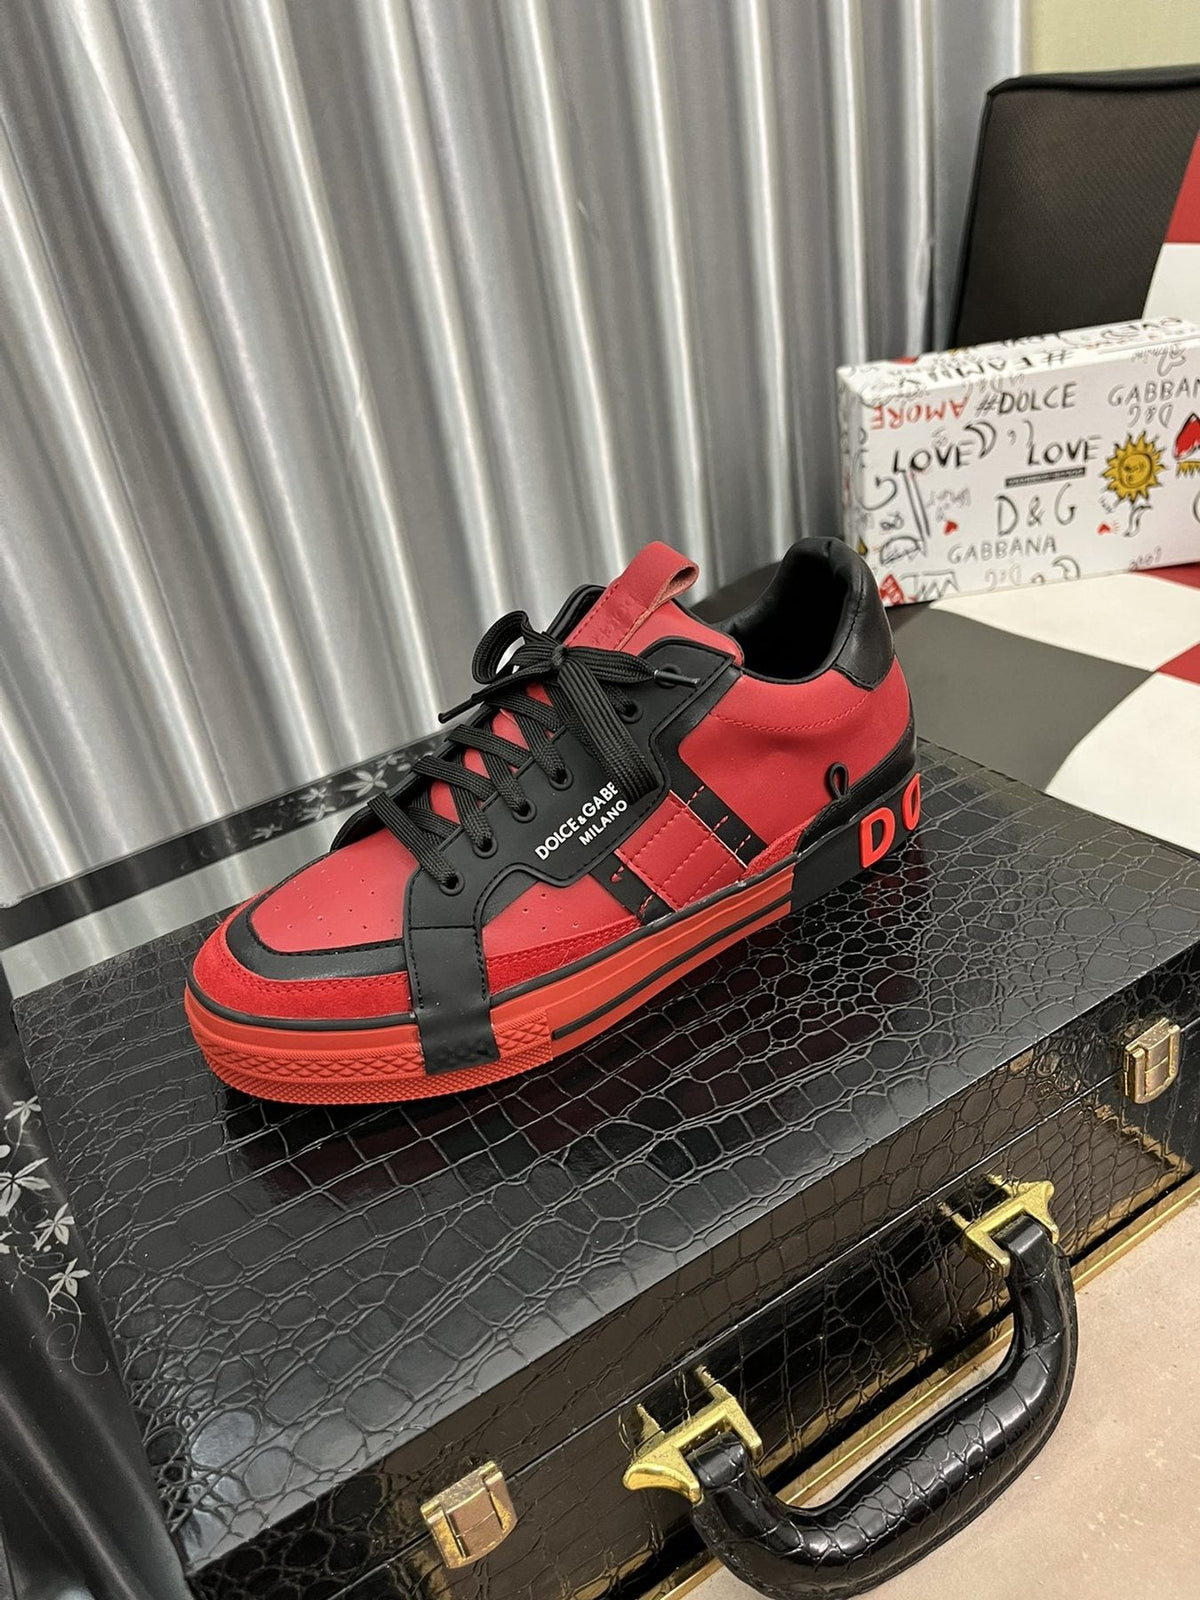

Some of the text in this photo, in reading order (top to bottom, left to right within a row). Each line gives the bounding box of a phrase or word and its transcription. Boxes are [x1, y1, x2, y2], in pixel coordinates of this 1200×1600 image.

[869, 395, 969, 431] AMORE
[974, 381, 1077, 416] #DOLCE
[893, 440, 975, 474] LOVE
[1028, 434, 1102, 466] LOVE
[947, 534, 1057, 565] GABBANA
[578, 799, 628, 846] MILANO
